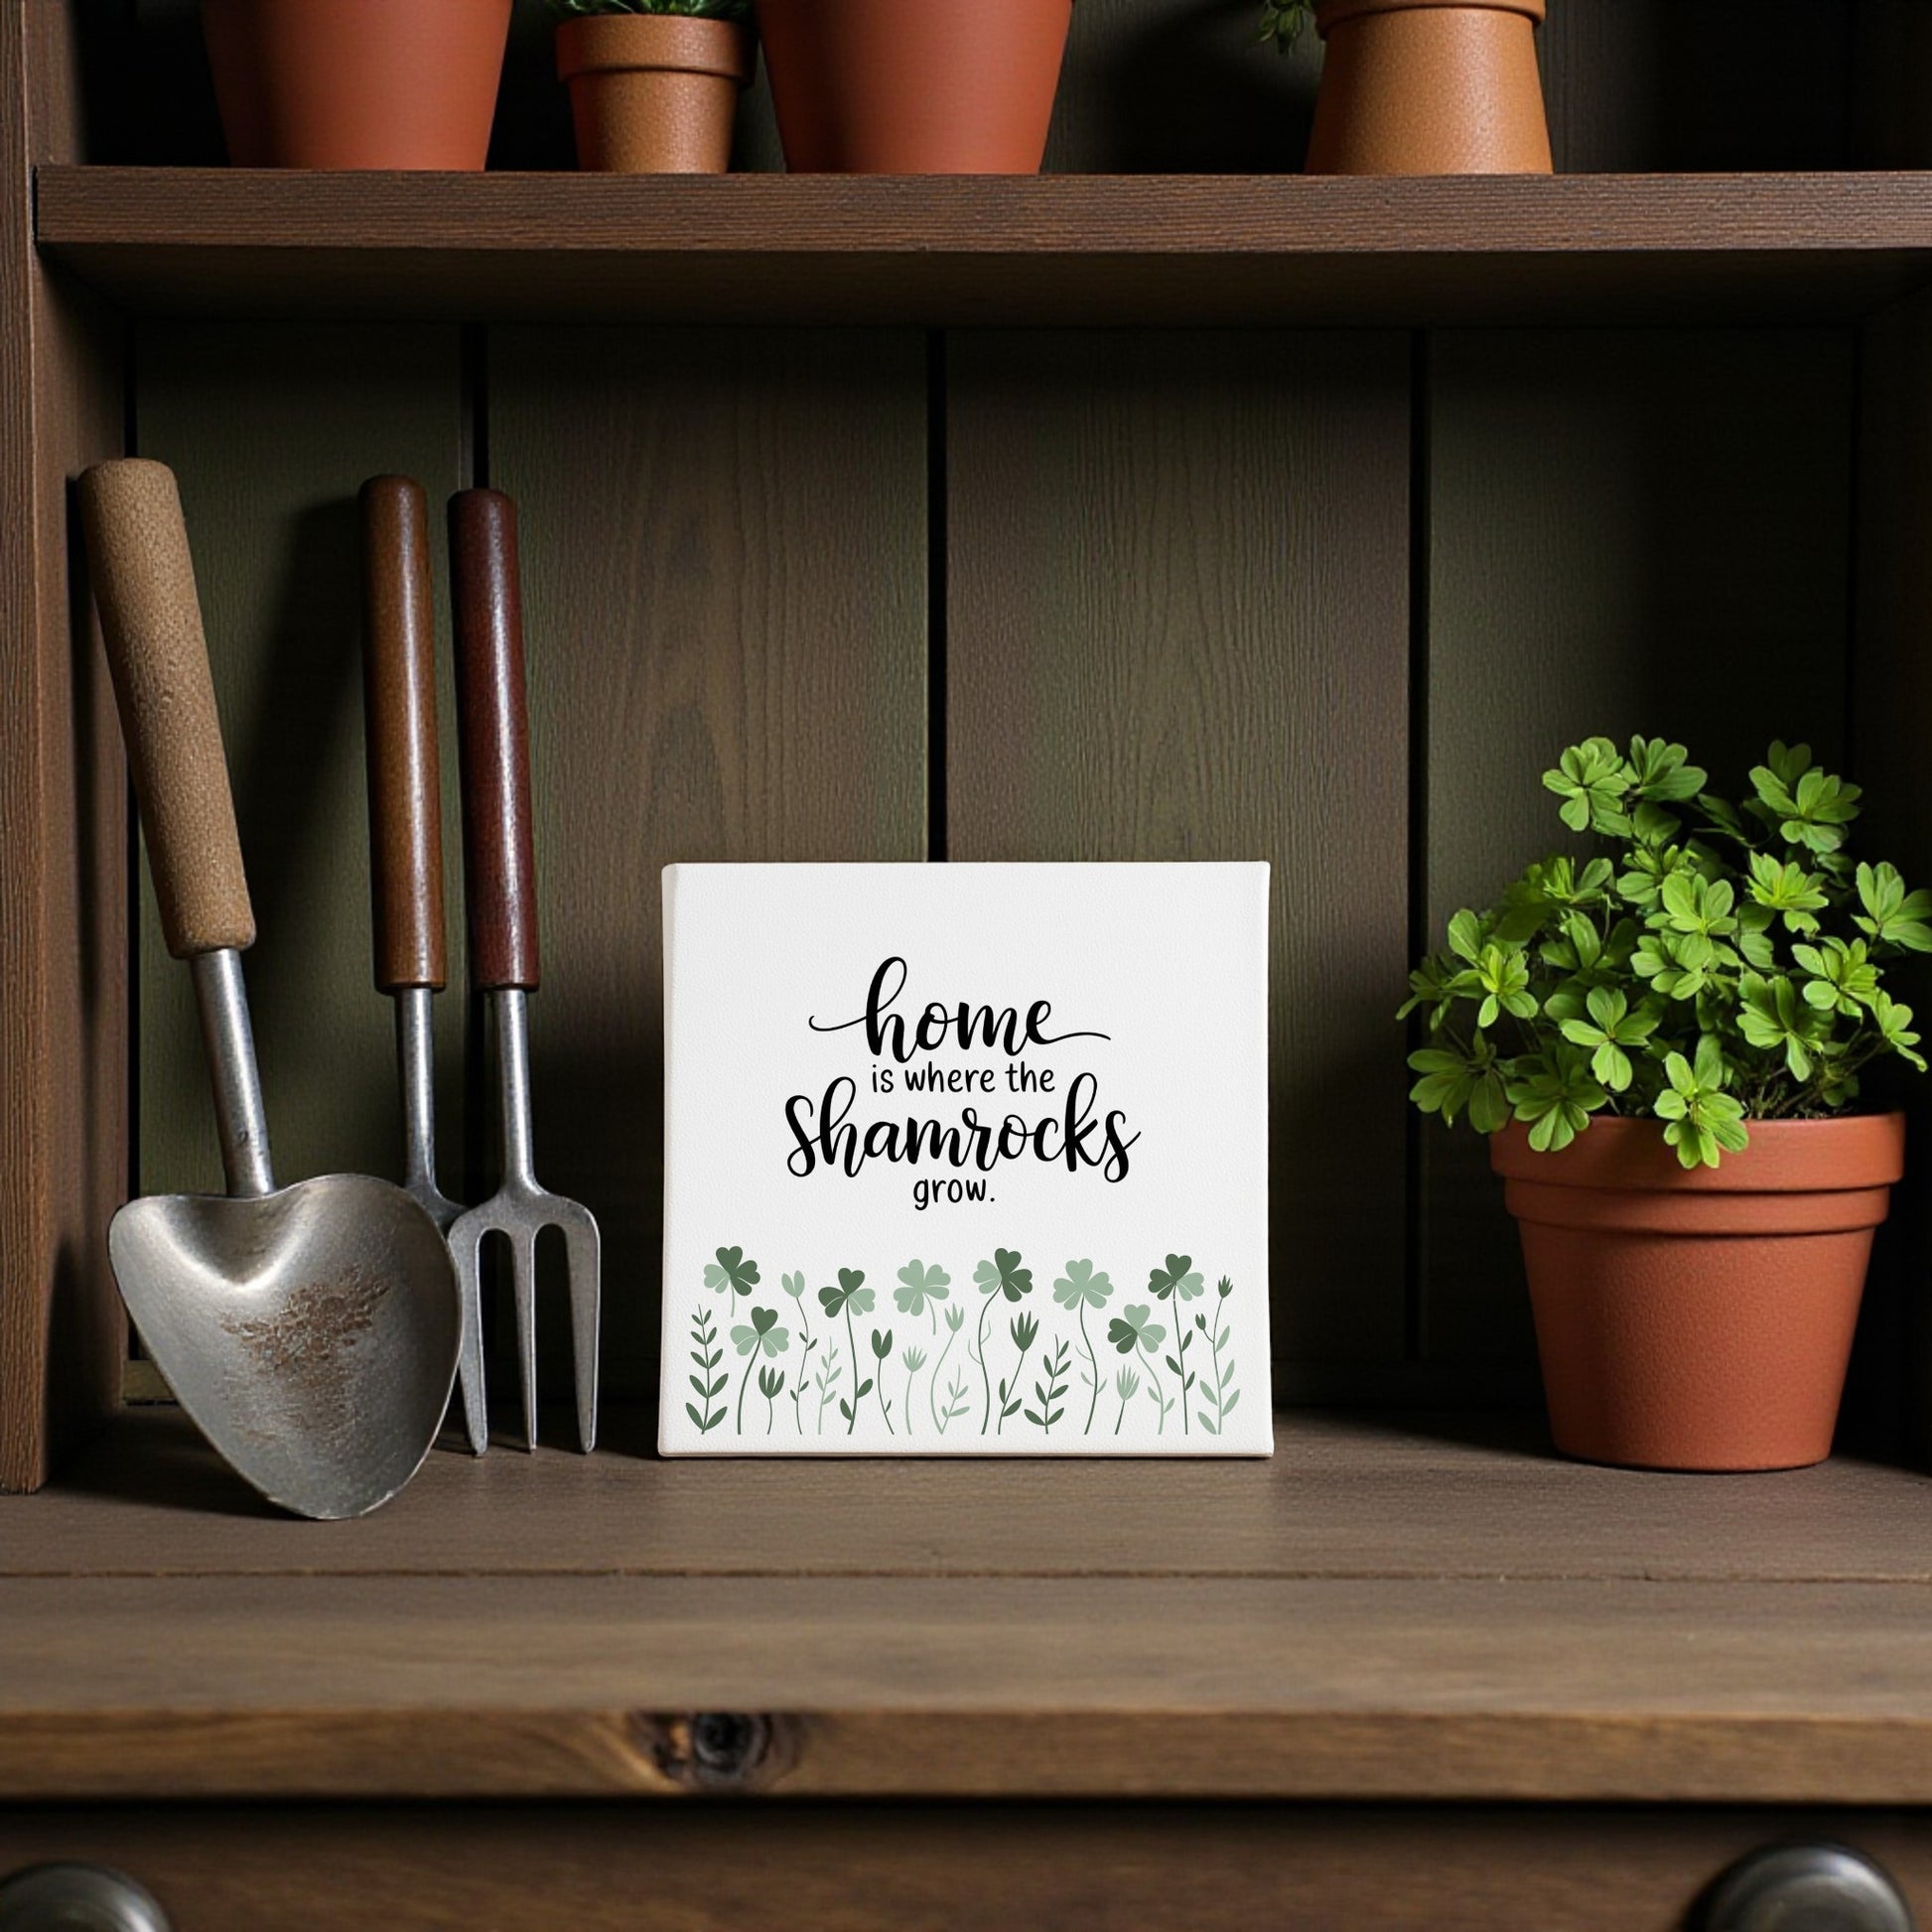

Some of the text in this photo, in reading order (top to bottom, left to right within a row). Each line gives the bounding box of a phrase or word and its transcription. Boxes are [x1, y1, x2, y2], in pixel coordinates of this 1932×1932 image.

[808, 956, 1112, 1064] home
[872, 1060, 1056, 1094] is where the
[912, 1178, 996, 1211] grow.
